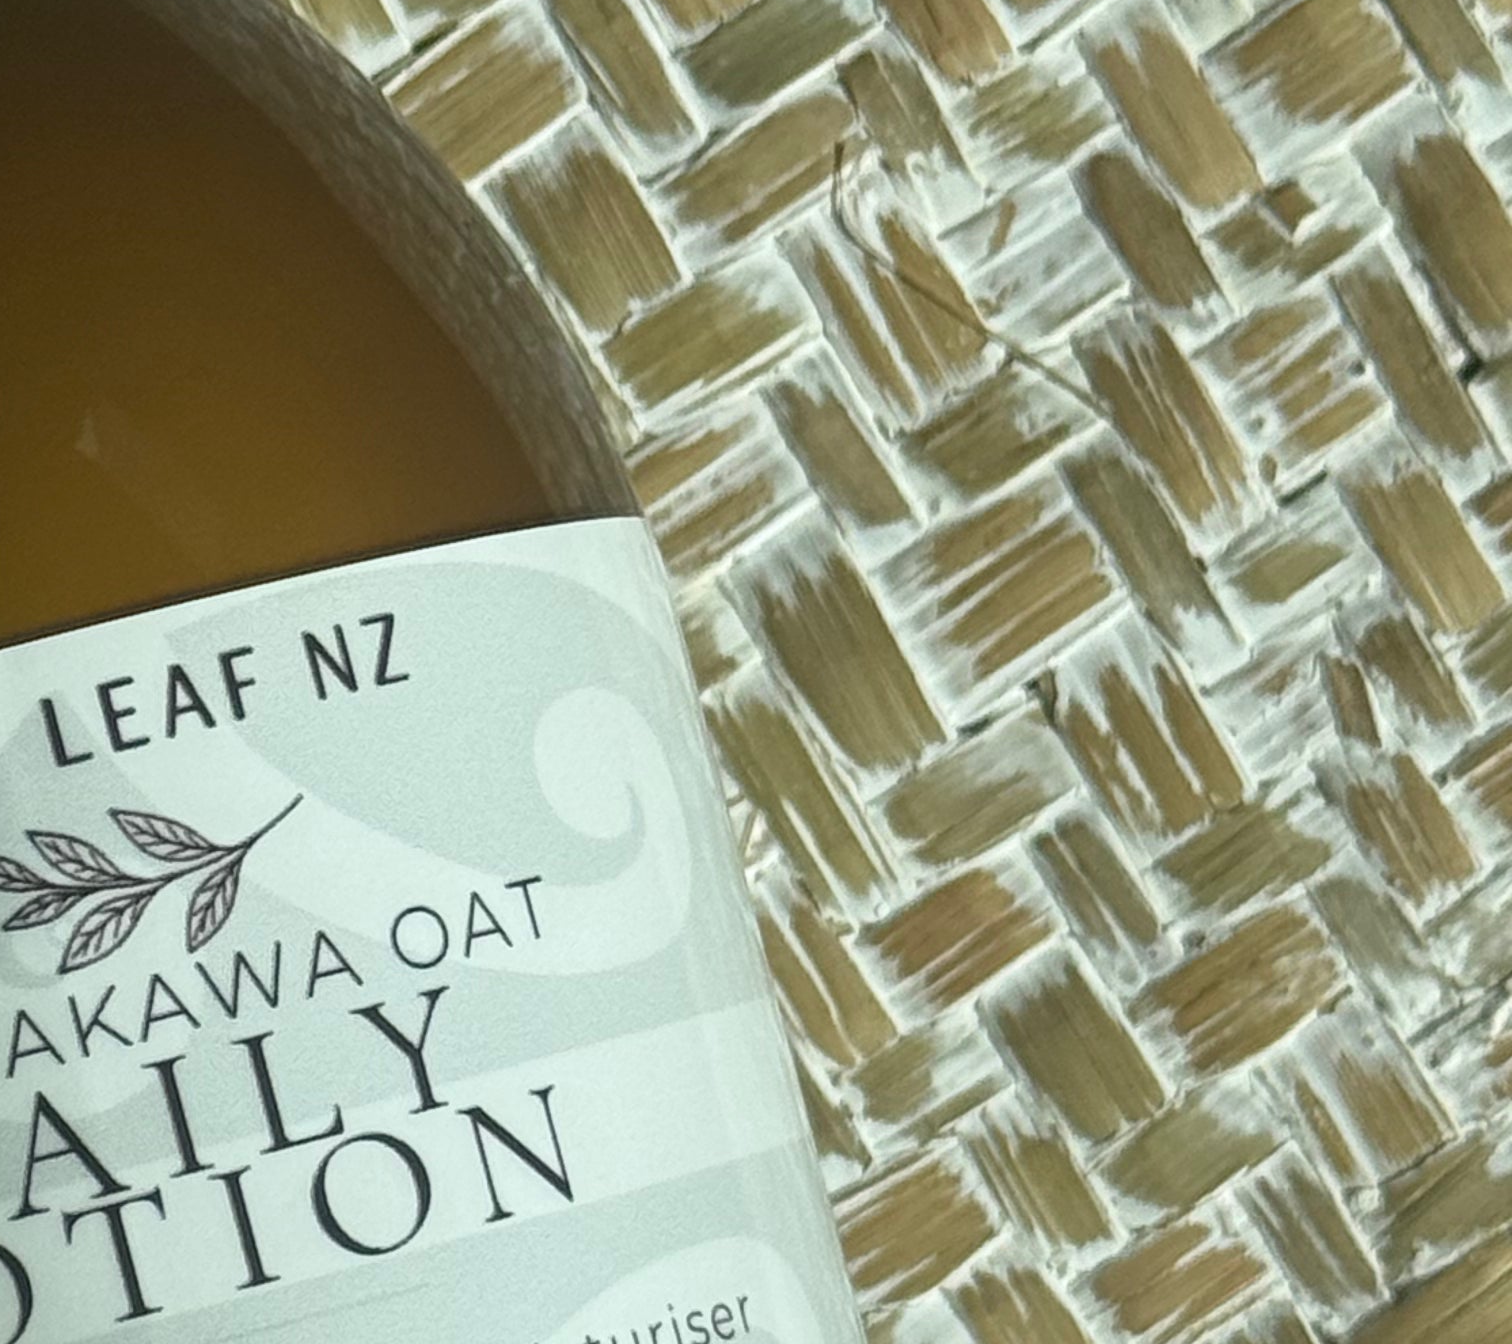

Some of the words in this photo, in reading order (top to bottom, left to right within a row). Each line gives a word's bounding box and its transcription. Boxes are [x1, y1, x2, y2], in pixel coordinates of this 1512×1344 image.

[38, 644, 258, 770] LEAF
[300, 611, 412, 703] NZ
[388, 873, 545, 972] OAT
